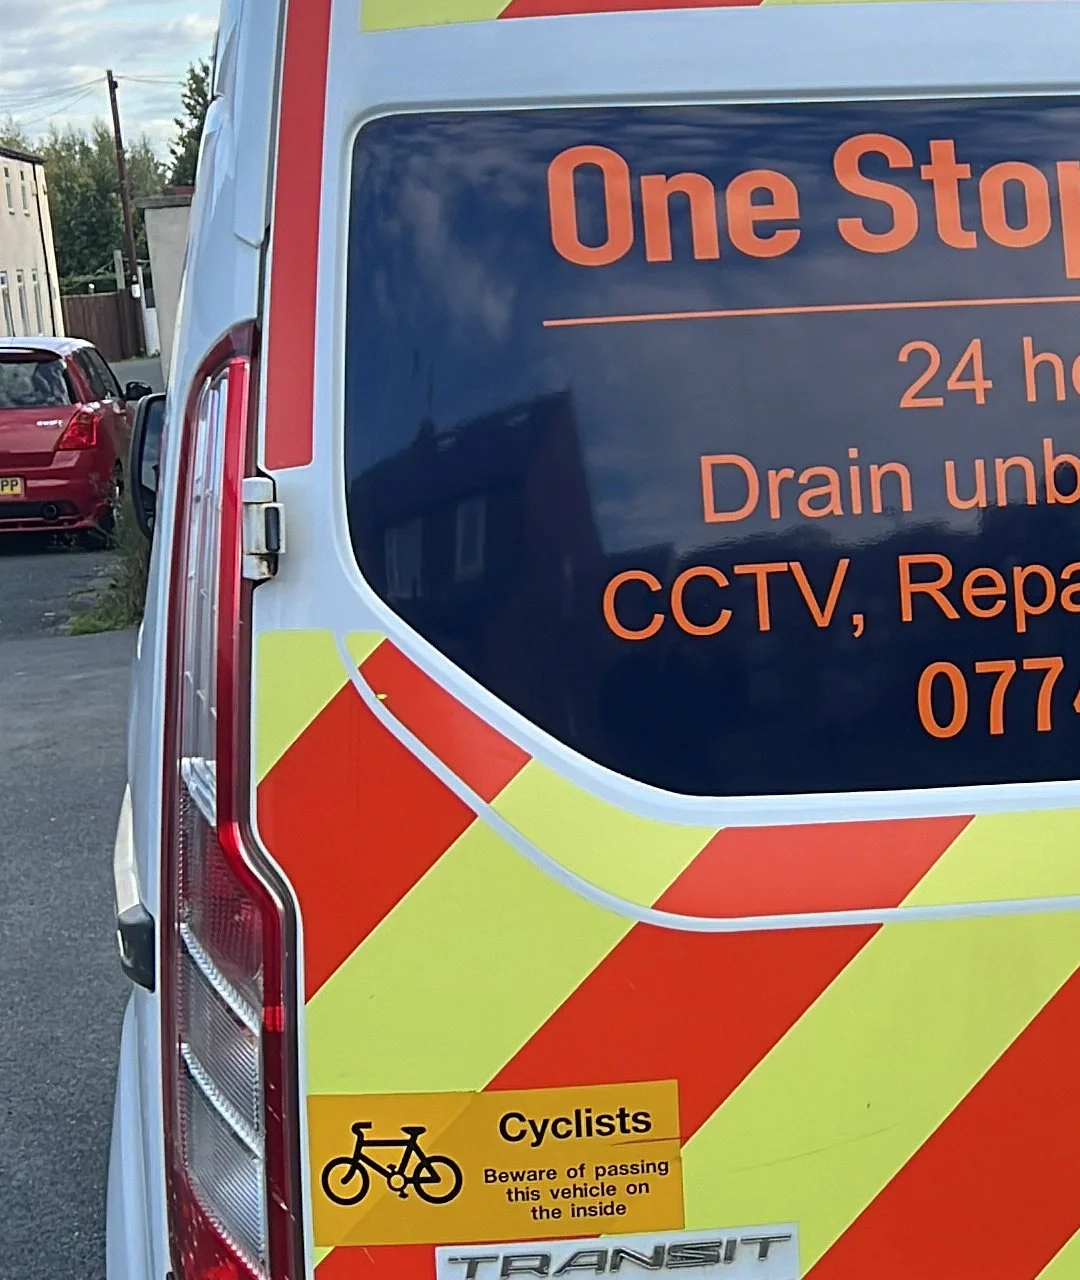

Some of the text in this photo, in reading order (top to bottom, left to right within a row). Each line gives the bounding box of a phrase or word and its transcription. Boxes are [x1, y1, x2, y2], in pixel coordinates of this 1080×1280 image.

[548, 147, 800, 267] One
[898, 340, 993, 408] 24
[701, 448, 912, 524] Drain
[603, 559, 864, 641] CCTV,
[499, 1107, 653, 1148] Cyclists
[485, 1160, 669, 1184] Beware of passing
[507, 1182, 650, 1202] this vehicle on
[531, 1201, 627, 1220] the inside
